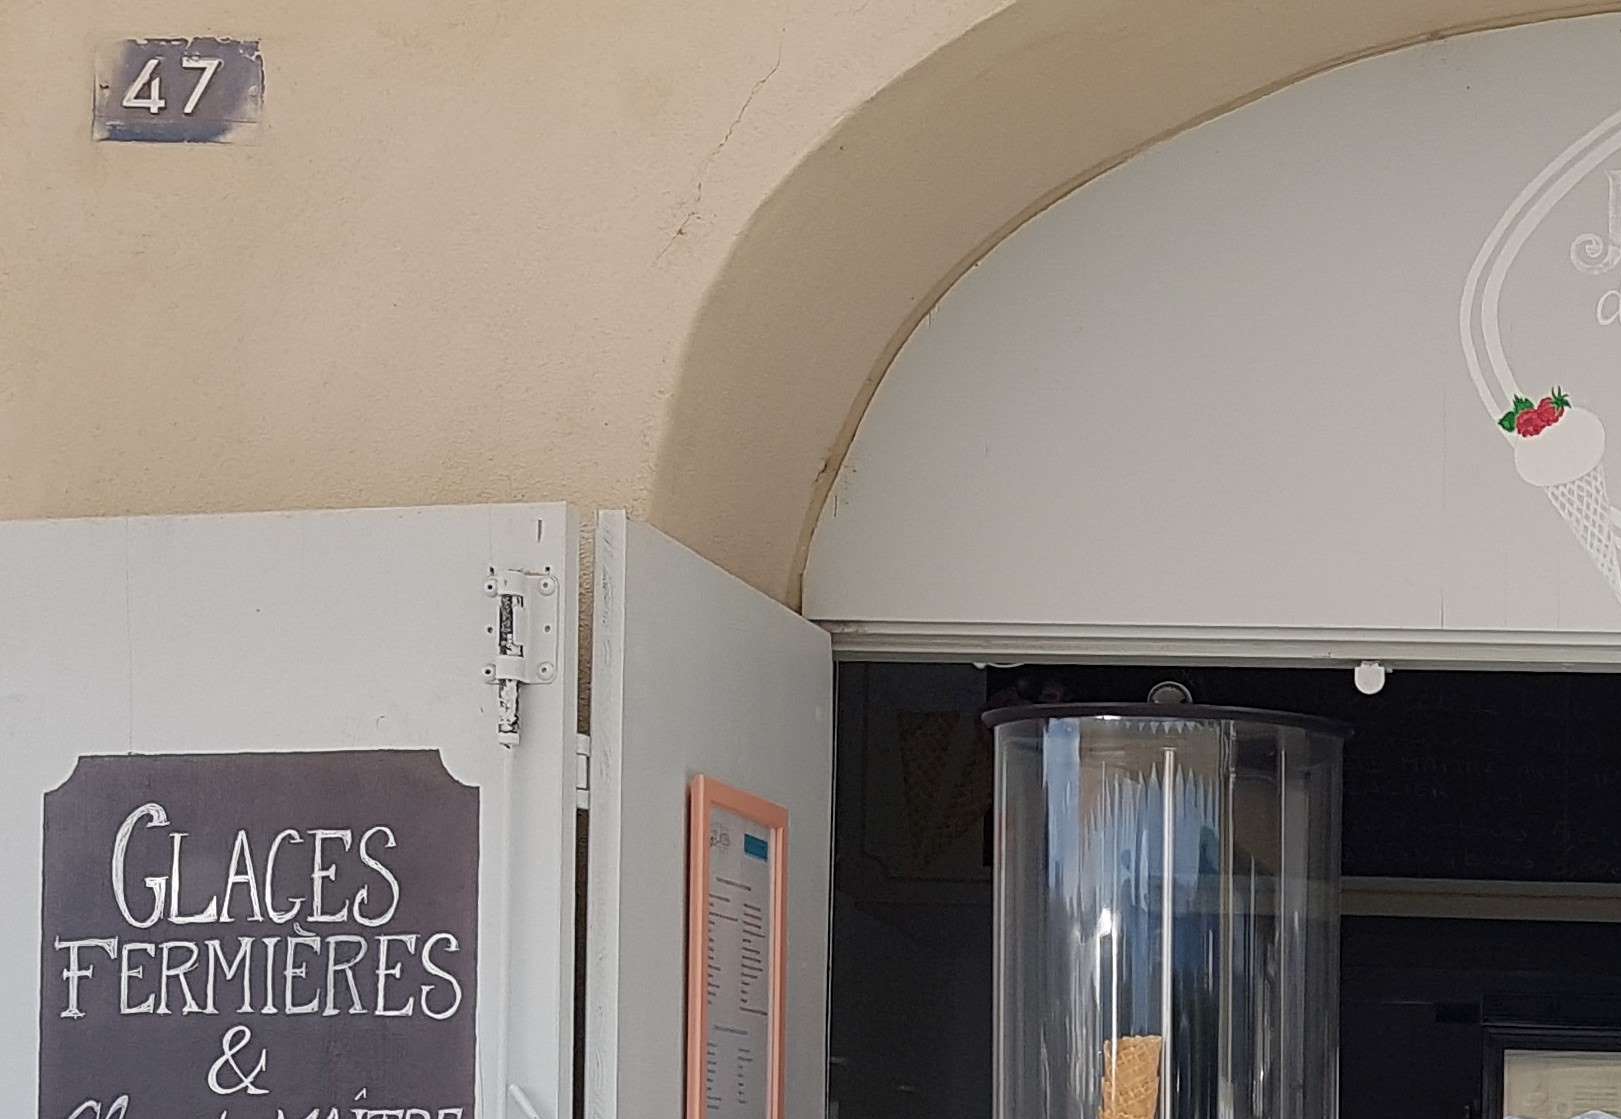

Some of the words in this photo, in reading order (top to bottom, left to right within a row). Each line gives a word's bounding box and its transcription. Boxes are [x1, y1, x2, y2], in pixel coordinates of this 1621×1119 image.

[122, 57, 223, 115] 47
[111, 803, 399, 929] GLACES
[55, 923, 462, 1020] FERMIÈRES
[207, 1025, 269, 1095] &
